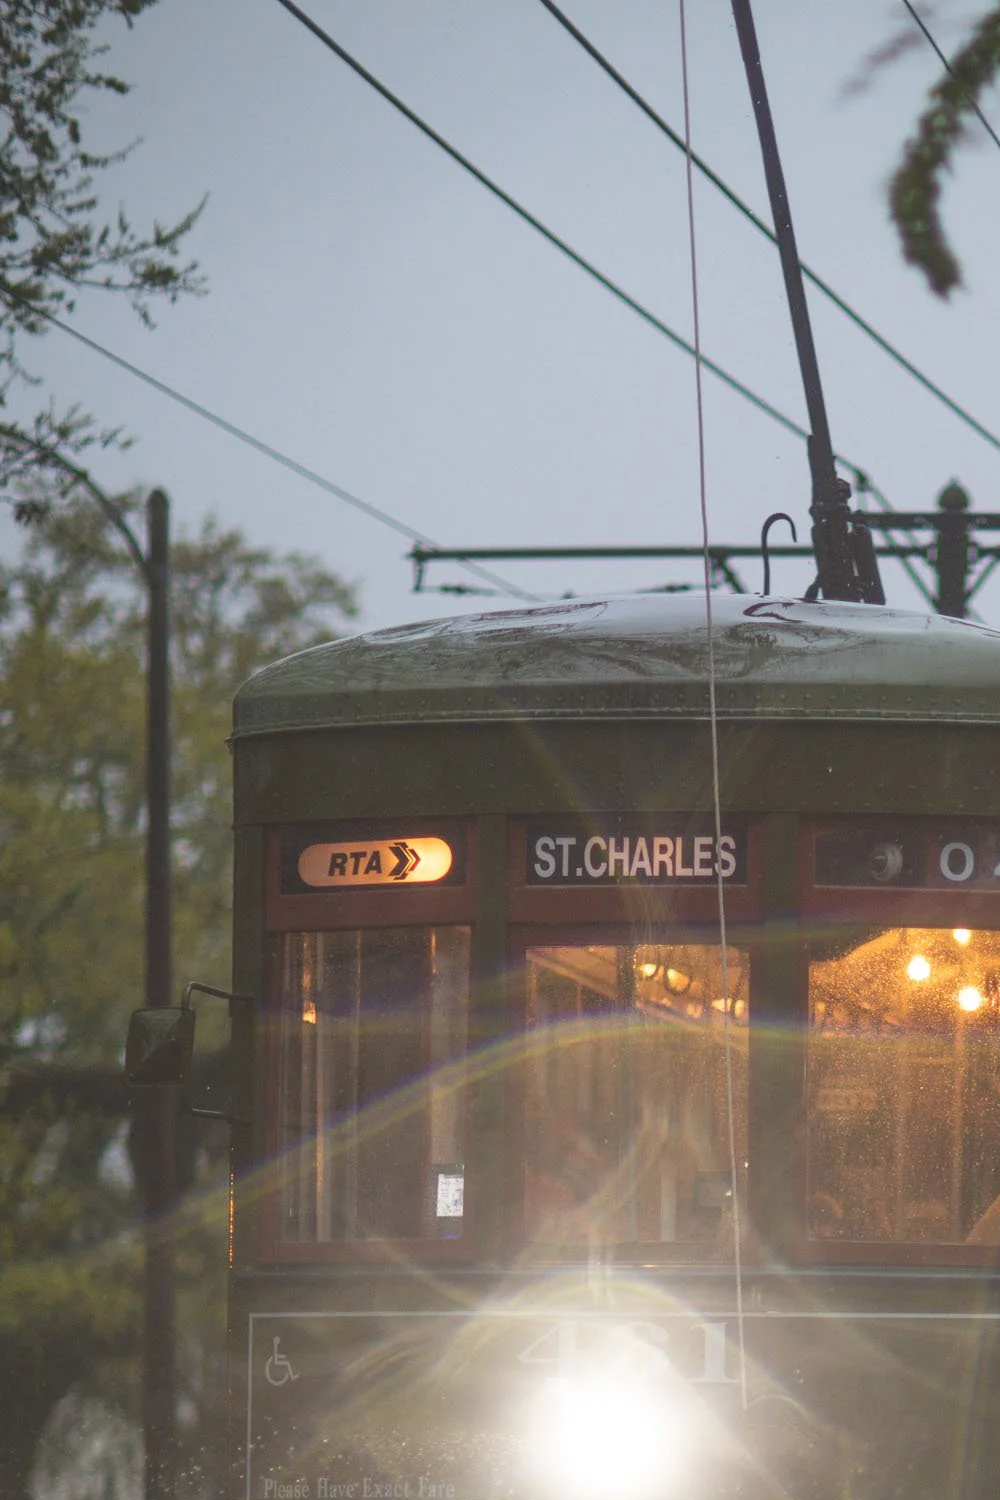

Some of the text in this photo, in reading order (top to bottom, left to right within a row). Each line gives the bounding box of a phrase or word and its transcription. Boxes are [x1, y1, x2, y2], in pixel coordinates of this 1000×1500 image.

[327, 850, 383, 877] RTA
[263, 1476, 456, 1498] Please Have Exact Fare
